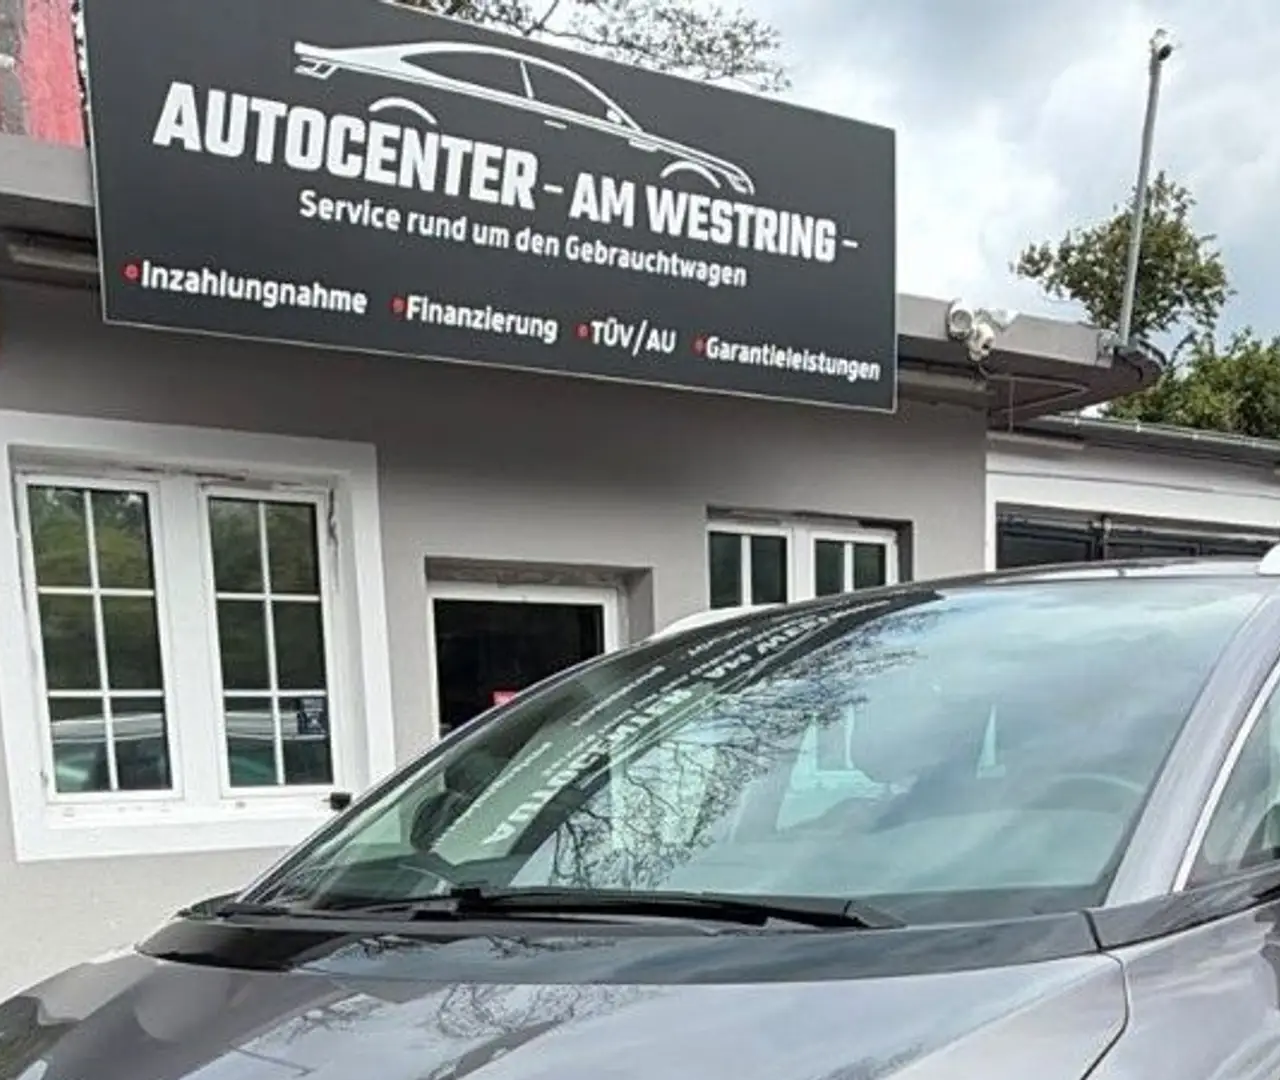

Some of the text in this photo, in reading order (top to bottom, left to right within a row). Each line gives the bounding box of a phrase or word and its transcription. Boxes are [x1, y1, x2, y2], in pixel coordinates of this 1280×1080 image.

[152, 80, 539, 210] AUTOCENTER
[569, 171, 636, 229] AM
[645, 184, 838, 263] WESTRING
[298, 188, 748, 289] Service rund um den Gebrauchtwagen
[140, 258, 369, 316] Inzahlungnahme
[405, 293, 558, 344] Finanzierung
[589, 316, 677, 357] TÜV/AU
[705, 335, 882, 384] Garantieleistungen
